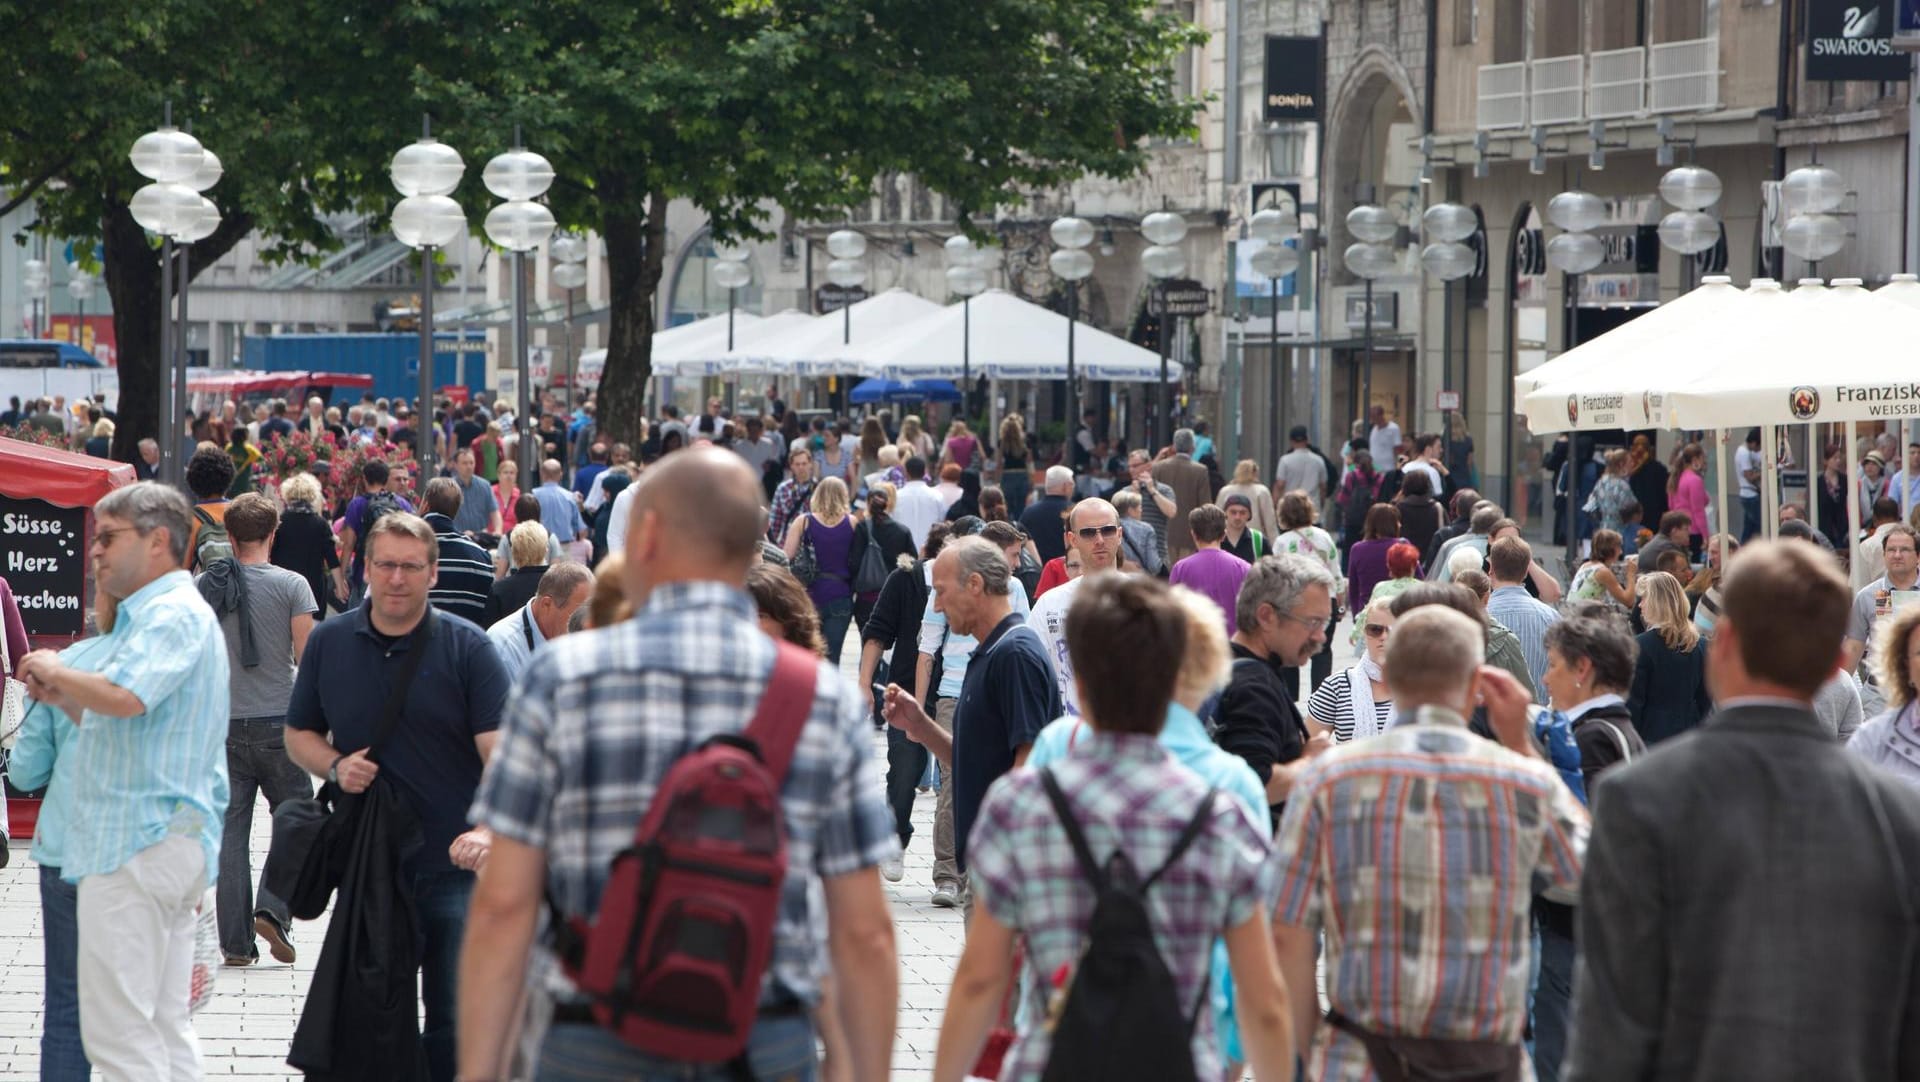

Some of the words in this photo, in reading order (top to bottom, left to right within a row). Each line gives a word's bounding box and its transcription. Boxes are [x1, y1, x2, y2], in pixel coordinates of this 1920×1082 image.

[1813, 38, 1905, 56] SWAROVS
[1268, 93, 1314, 109] BONITA
[1583, 393, 1623, 411] Franziskaner
[3, 513, 62, 534] Süsse
[8, 551, 58, 572] Herz
[9, 589, 79, 610] rschen
